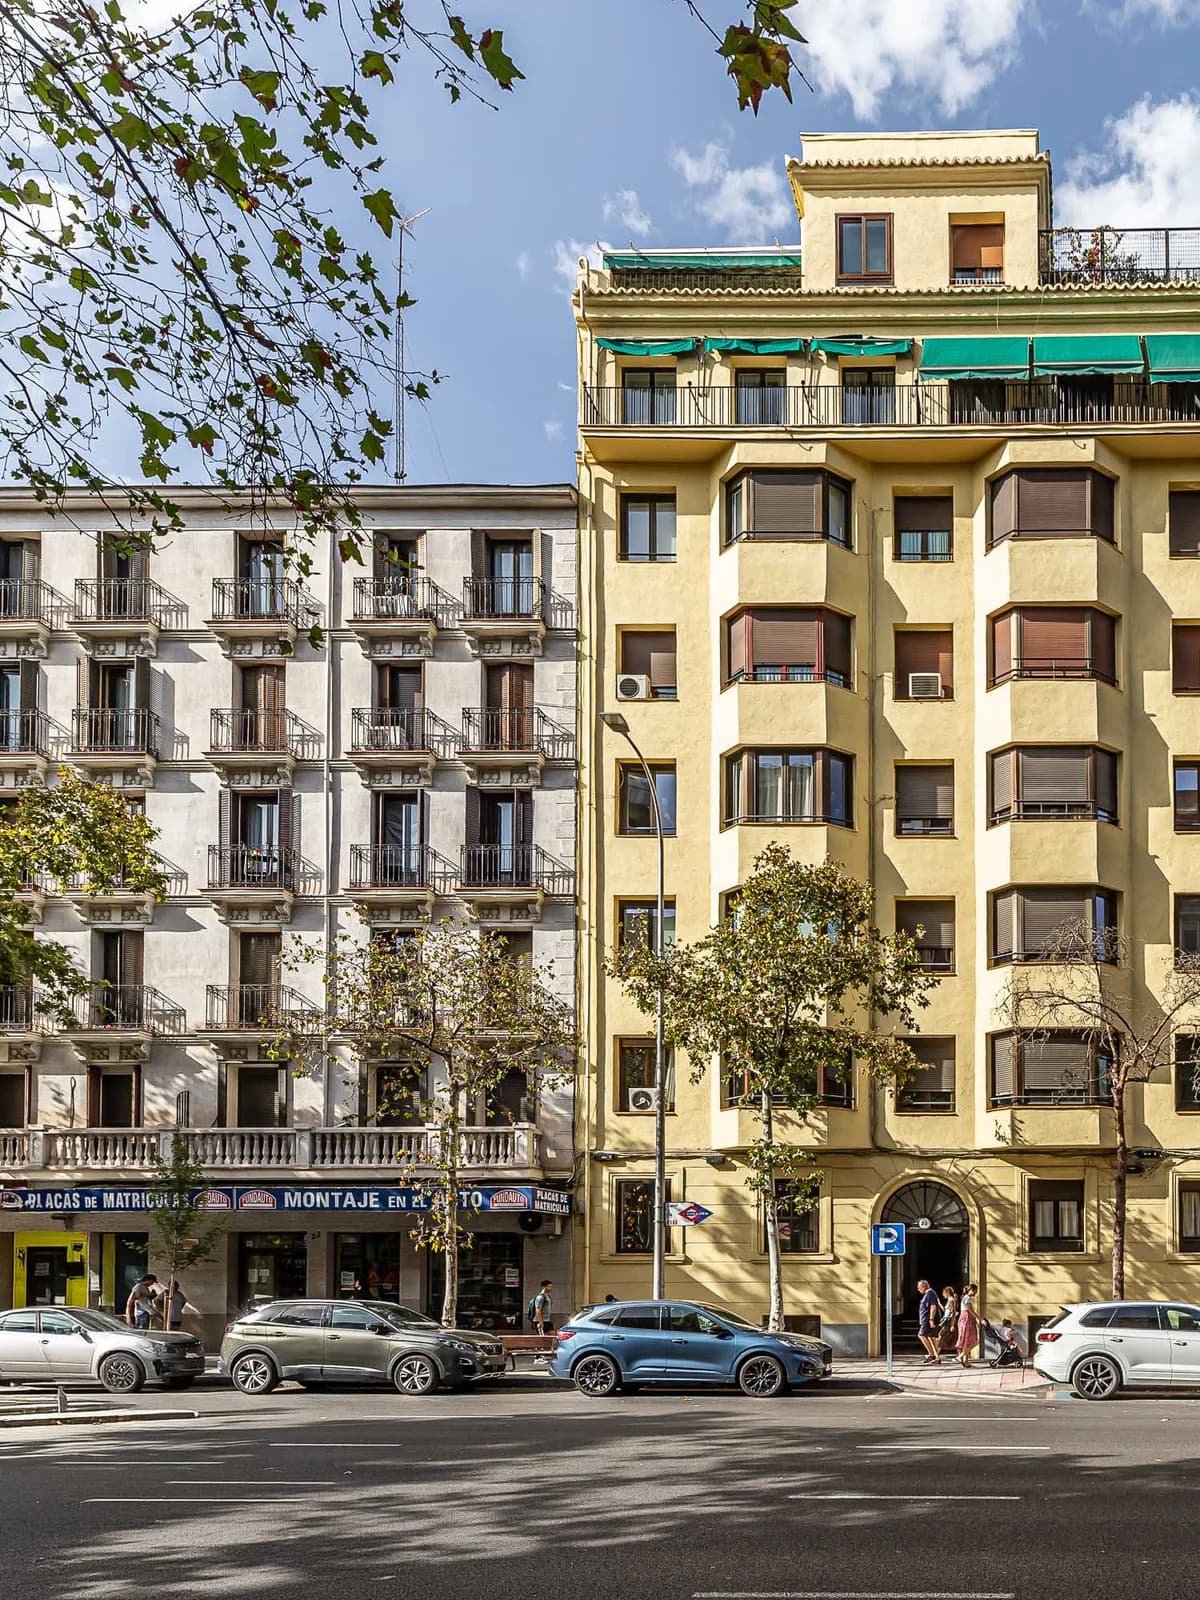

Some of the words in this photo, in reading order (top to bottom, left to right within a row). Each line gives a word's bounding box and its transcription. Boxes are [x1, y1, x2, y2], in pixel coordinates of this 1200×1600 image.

[85, 1196, 97, 1209] DE
[242, 1192, 274, 1205] FUNDAUTO
[284, 1191, 380, 1209] MONTAJE
[388, 1196, 406, 1209] EN
[432, 1191, 483, 1208] ATO
[493, 1192, 525, 1204] FUNDAUTO
[536, 1190, 559, 1203] PLACAS
[560, 1194, 568, 1203] DE
[534, 1200, 570, 1214] MATRICULAS
[879, 1227, 898, 1251] P
